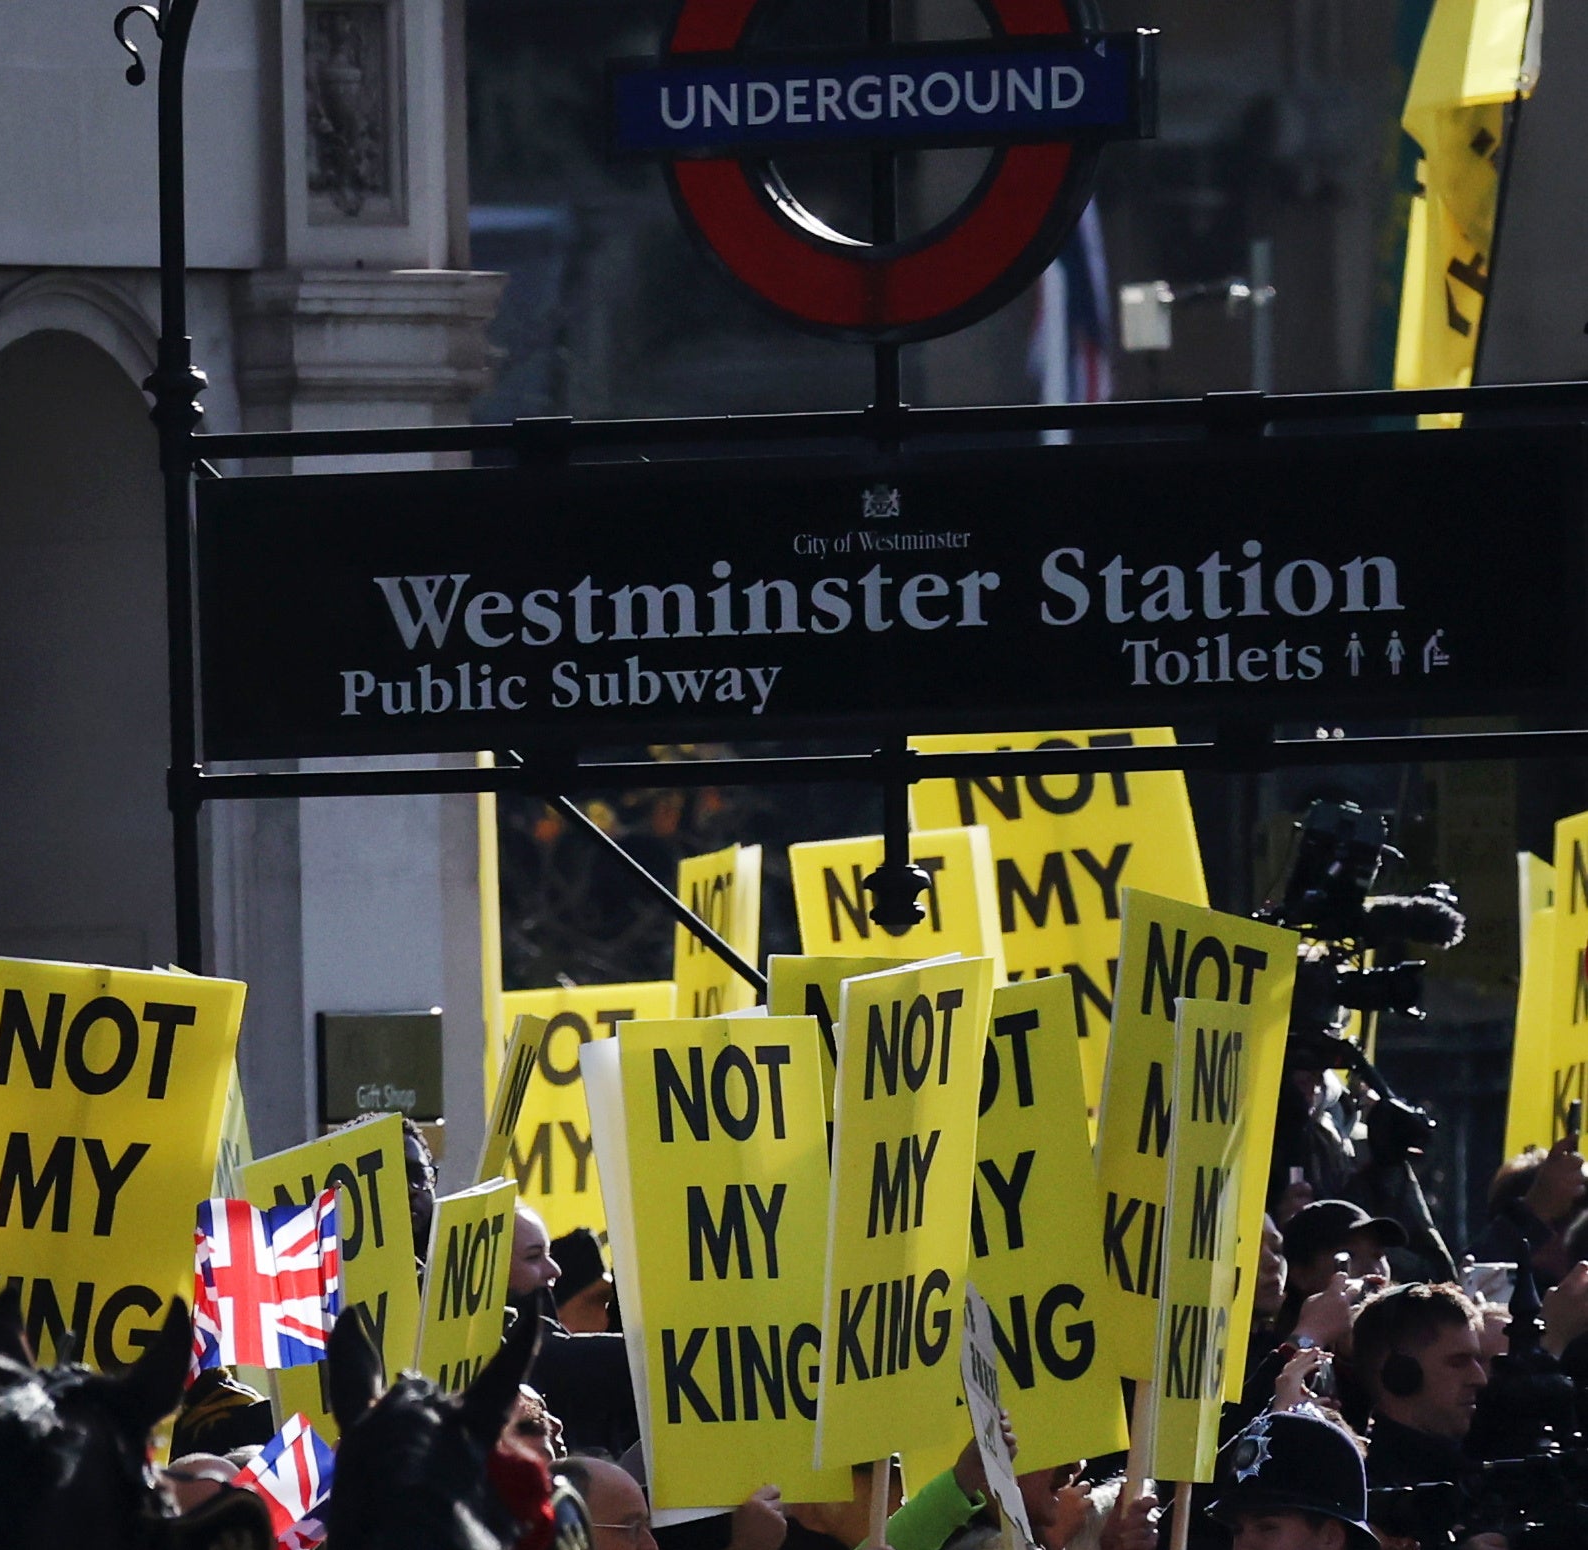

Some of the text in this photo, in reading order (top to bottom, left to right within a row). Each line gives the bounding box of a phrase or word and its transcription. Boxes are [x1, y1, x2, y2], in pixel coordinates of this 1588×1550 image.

[661, 65, 1085, 130] UNDERGROUND
[794, 529, 971, 559] City of Westminster
[373, 540, 1405, 650] Westminster Station
[340, 634, 1324, 716] Public Subway Toilets
[954, 732, 1134, 827] NOT
[822, 856, 945, 942] NT
[996, 843, 1134, 933] MY
[1141, 921, 1268, 1022] NOT
[653, 1044, 791, 1143] NOT
[864, 989, 964, 1101] NOT
[1192, 1027, 1242, 1125] NOT
[357, 1083, 416, 1112] Gift Shop
[687, 1183, 787, 1282] MY
[866, 1129, 942, 1239] MY
[438, 1213, 505, 1321] NOT
[662, 1323, 824, 1424] KING
[835, 1268, 952, 1385] KING
[1166, 1304, 1226, 1400] KING
